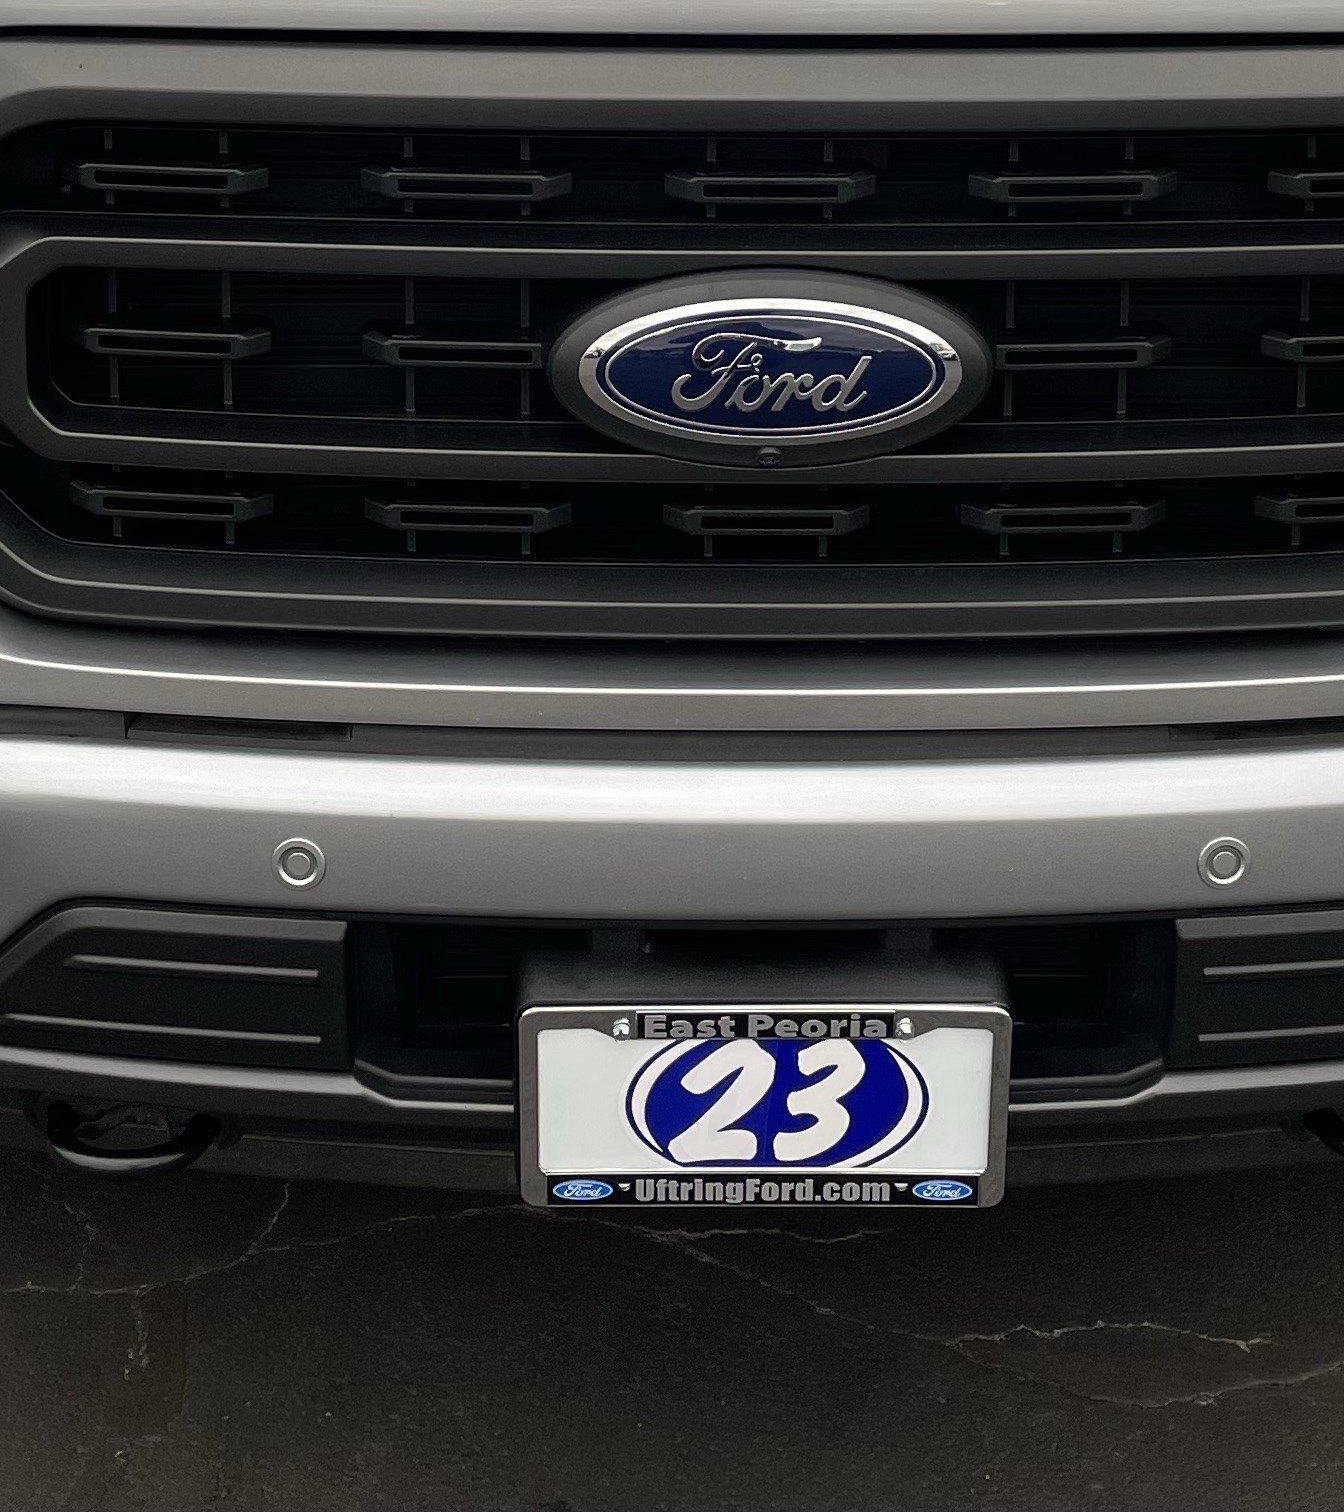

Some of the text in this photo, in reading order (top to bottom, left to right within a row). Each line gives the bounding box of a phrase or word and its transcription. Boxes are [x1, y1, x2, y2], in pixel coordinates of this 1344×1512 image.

[671, 332, 873, 413] Ford
[643, 1013, 888, 1039] East Peoria
[667, 1038, 866, 1163] 23
[563, 1183, 603, 1197] Ford
[635, 1178, 891, 1204] UftringFord.com
[922, 1183, 962, 1197] Ford
